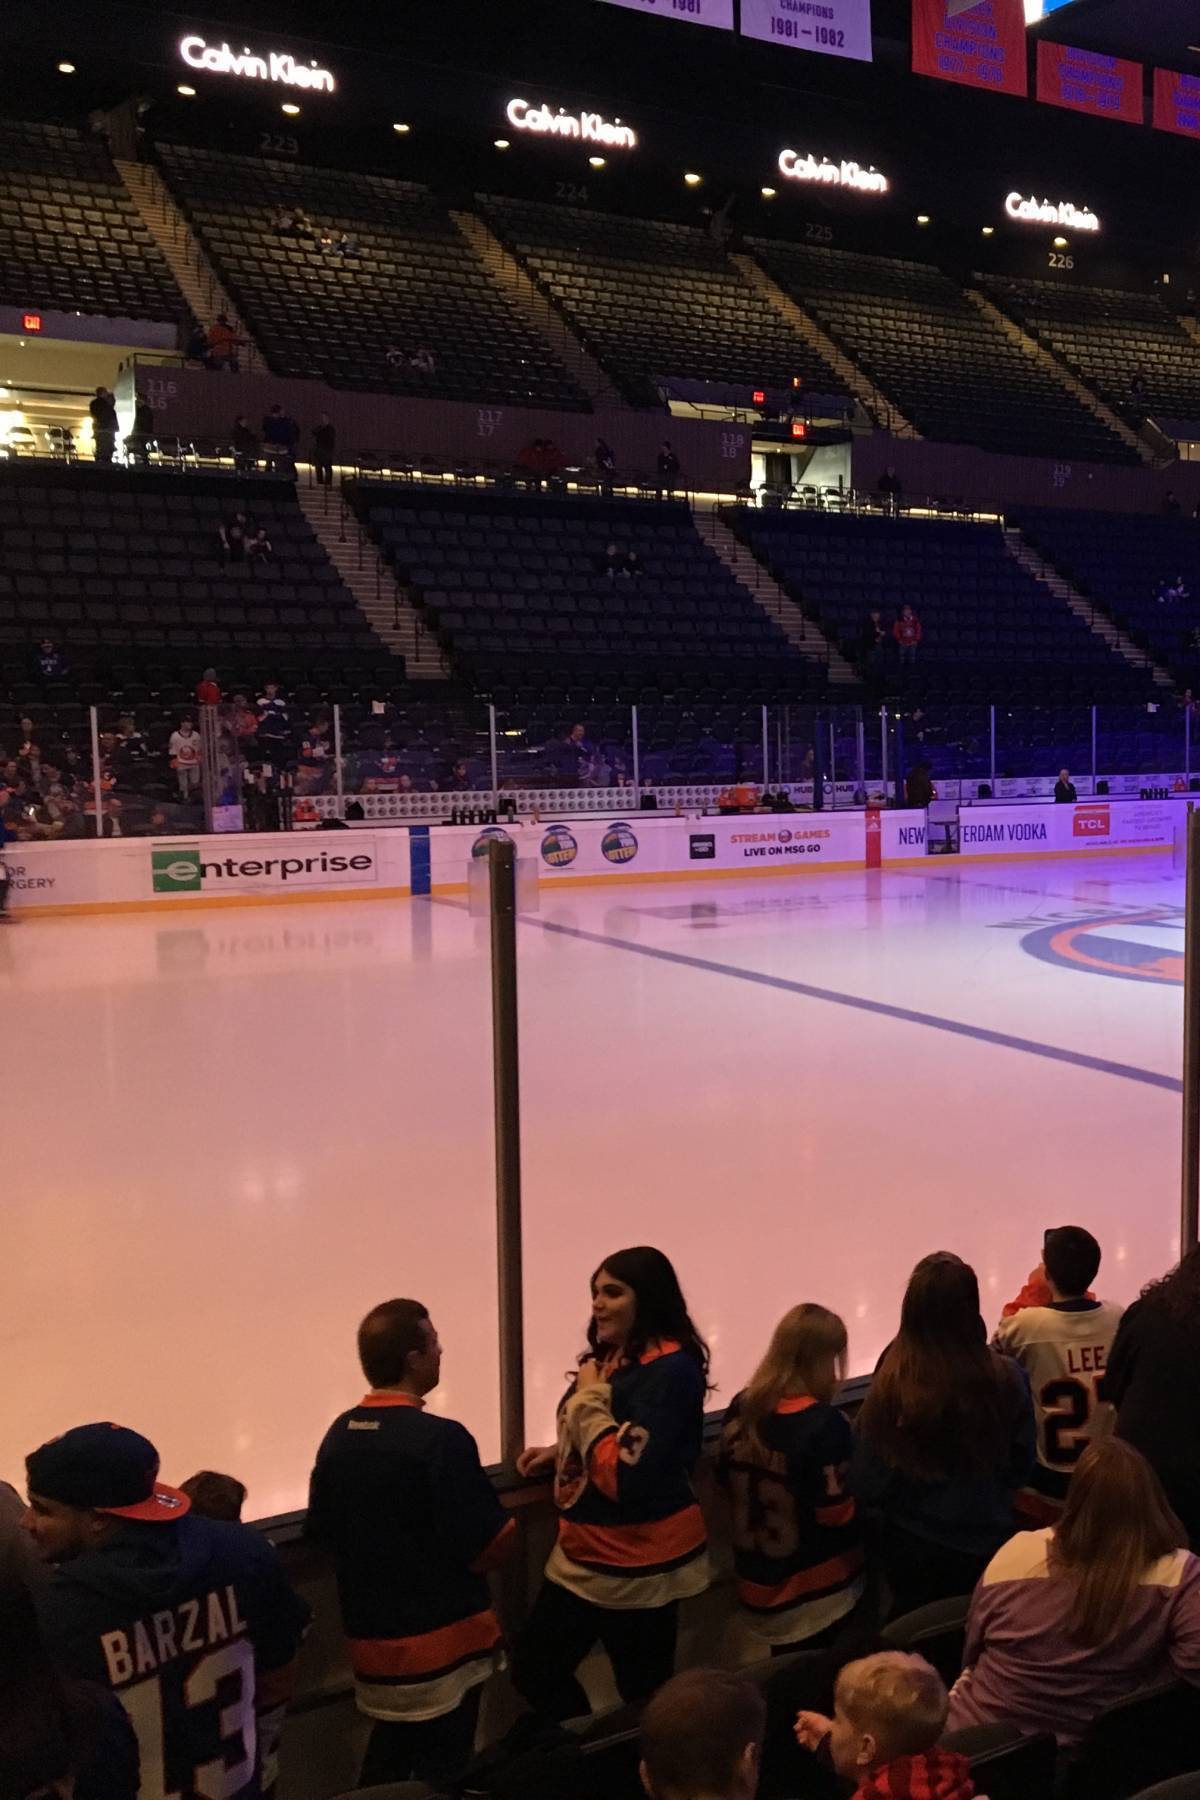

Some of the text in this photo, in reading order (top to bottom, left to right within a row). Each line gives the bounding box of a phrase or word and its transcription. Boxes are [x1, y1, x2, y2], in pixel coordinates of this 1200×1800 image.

[780, 0, 834, 20] CHAMPIONS
[180, 36, 334, 92] Calvin Klein
[506, 98, 636, 148] Calvin Klein
[261, 132, 298, 154] 223
[778, 149, 888, 193] Calvin Klein
[555, 181, 590, 203] 224
[1005, 191, 1058, 224] Calvin
[805, 223, 833, 241] 225
[1047, 252, 1075, 269] 226
[147, 378, 177, 394] 116
[835, 784, 854, 793] HUB
[899, 827, 926, 845] NEW
[1007, 822, 1047, 841] VODKA
[1078, 819, 1105, 830] TCL
[730, 833, 776, 844] STREAM
[794, 829, 831, 840] GAMES
[744, 844, 821, 857] LIVE ON MSG GO
[166, 851, 373, 882] enterprise
[6, 877, 56, 890] RGERY
[1067, 1345, 1106, 1373] LEE
[101, 1583, 248, 1685] BARZAL
[115, 1637, 257, 1800] 13
